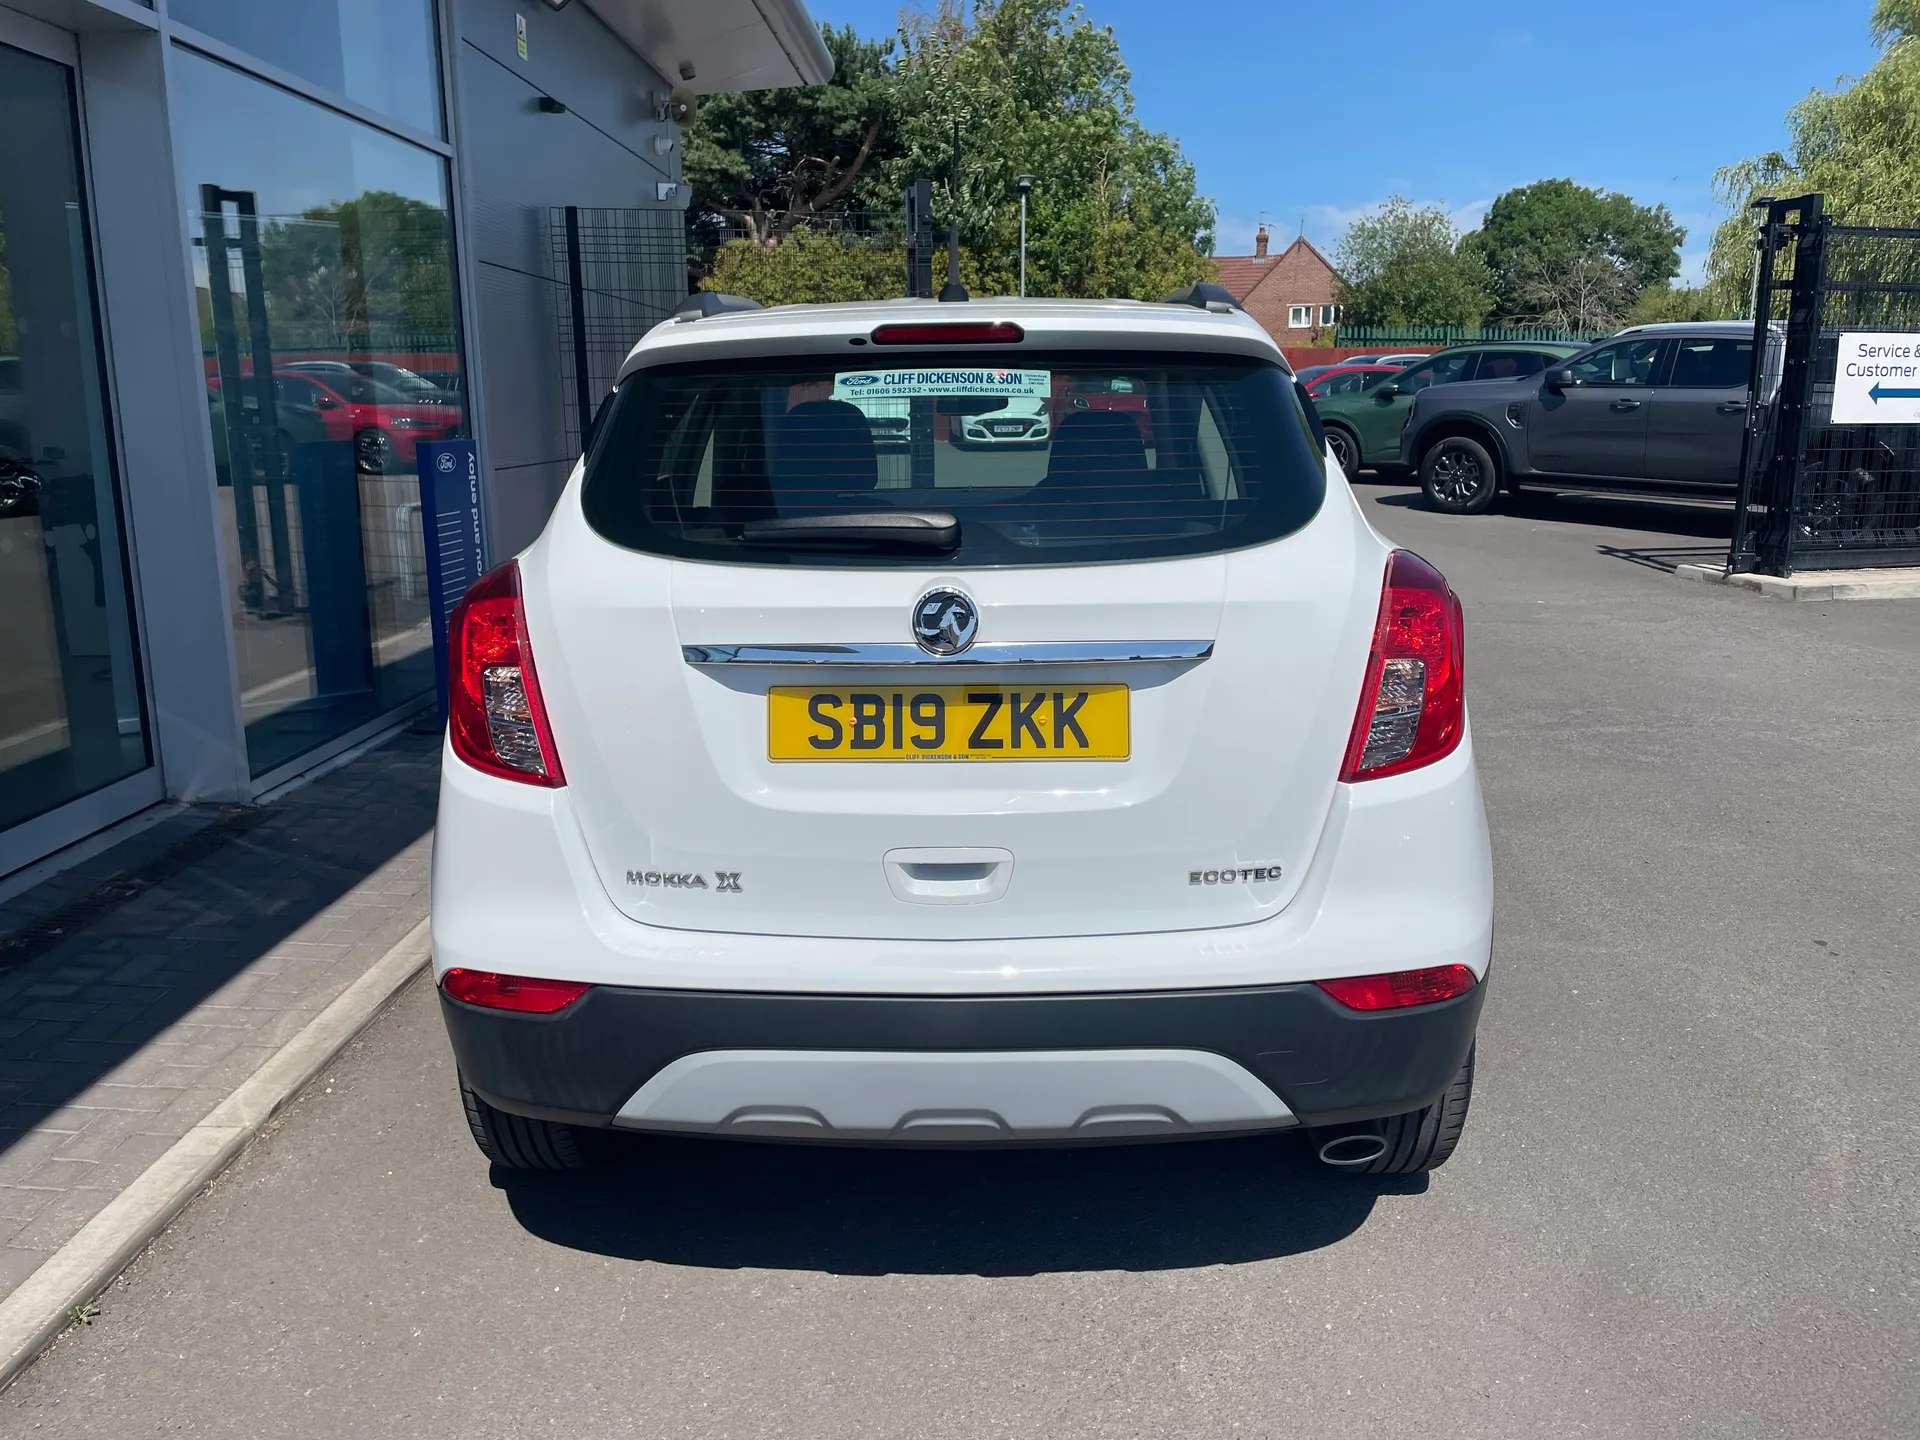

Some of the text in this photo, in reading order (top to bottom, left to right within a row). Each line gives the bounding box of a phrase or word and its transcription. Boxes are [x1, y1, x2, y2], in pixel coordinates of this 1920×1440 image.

[1858, 343, 1911, 358] Service
[1846, 362, 1917, 377] Customer
[846, 376, 874, 386] Ford
[883, 373, 915, 385] CLIFF
[917, 372, 984, 384] DICKENSON
[986, 373, 995, 384] &
[998, 373, 1022, 385] SON
[866, 387, 890, 395] 01606
[892, 386, 922, 394] 592352
[928, 386, 1034, 394] www.cliffdickenson.co.uk
[468, 452, 483, 576] ou and enjoy
[808, 692, 1089, 750] SB19 ZKK
[626, 870, 743, 892] MOKKA X
[1189, 866, 1282, 885] ECOTEC
